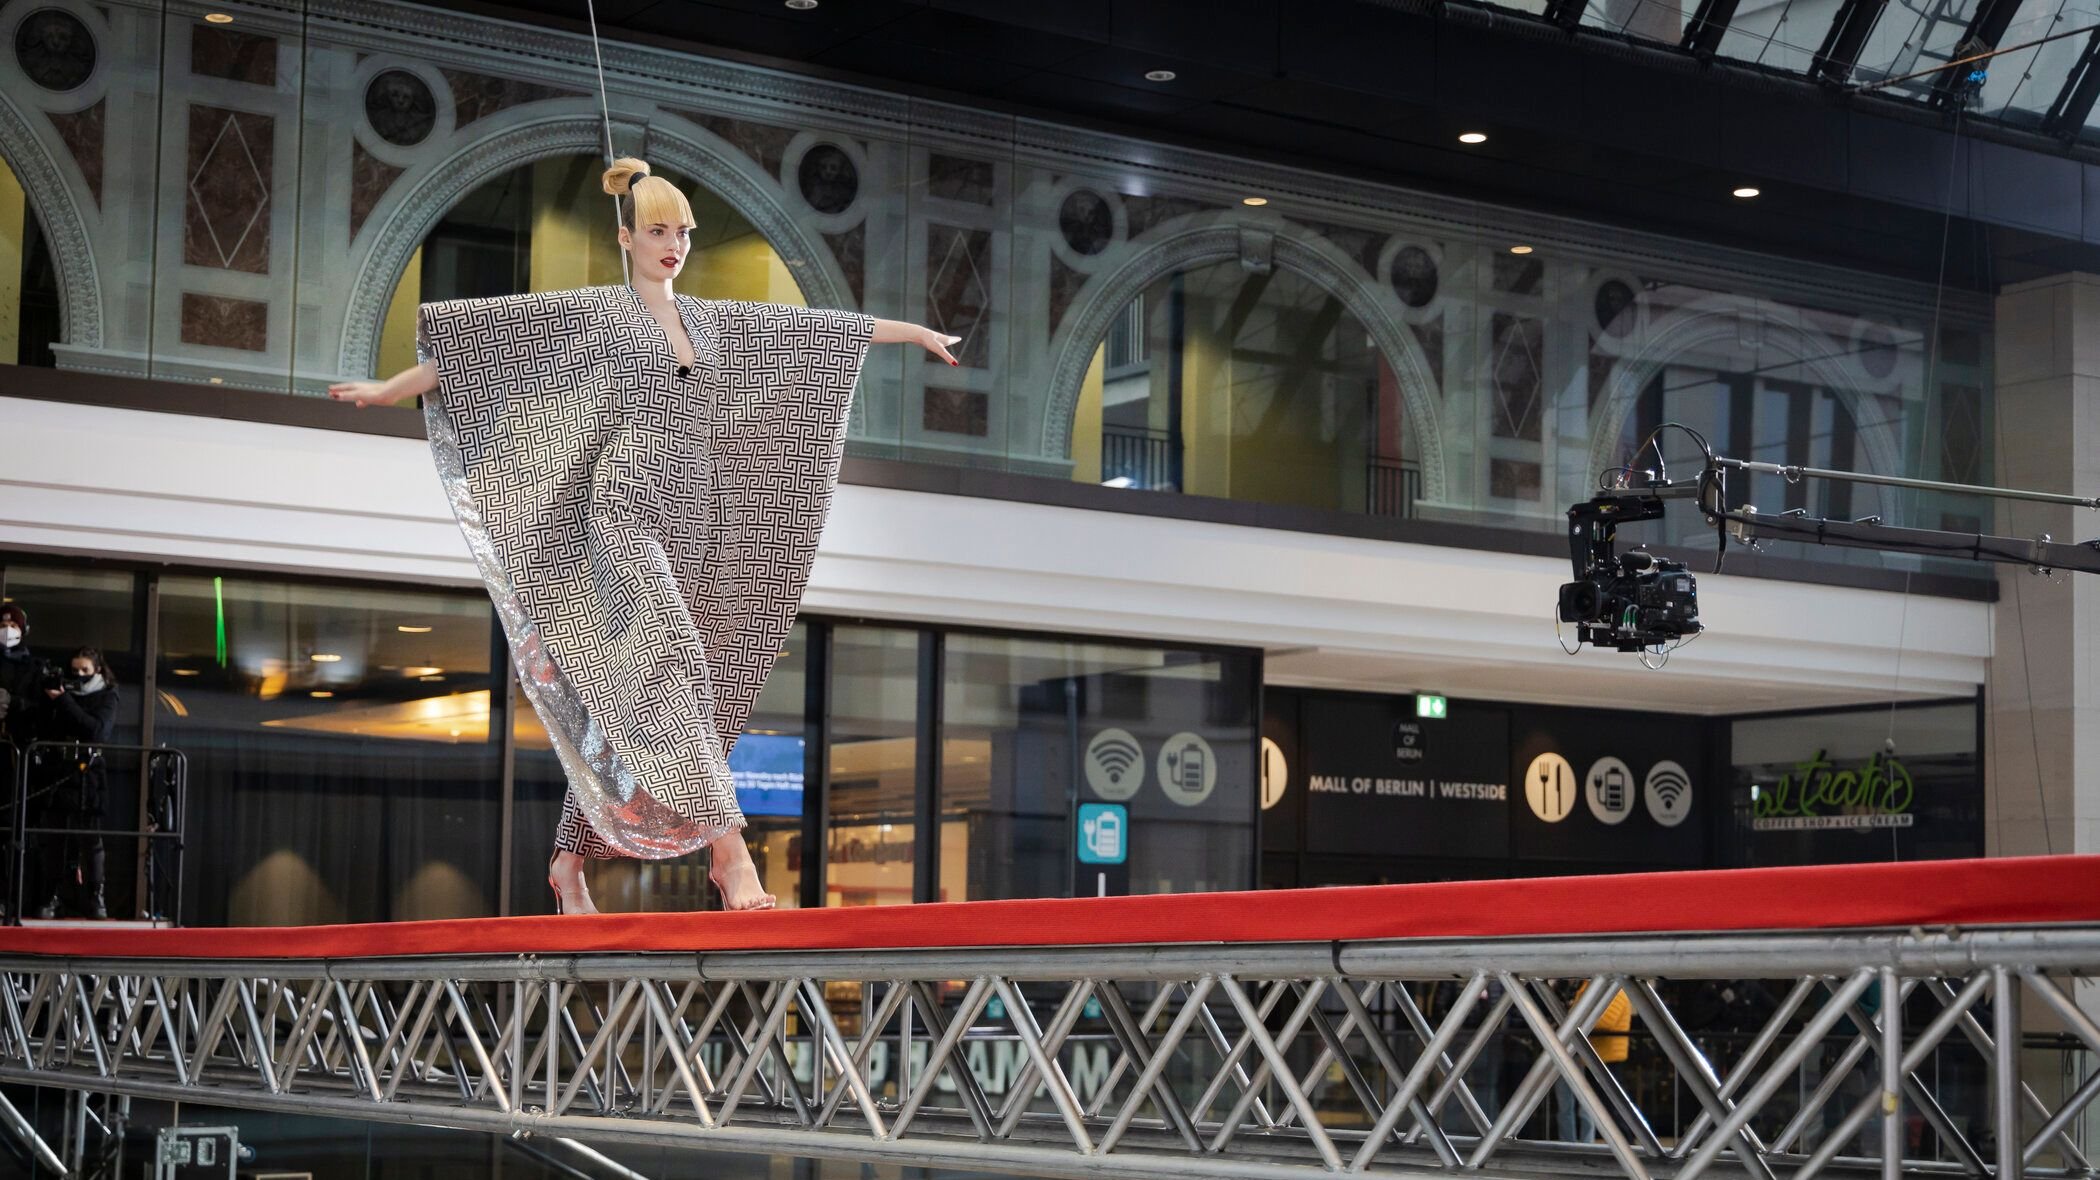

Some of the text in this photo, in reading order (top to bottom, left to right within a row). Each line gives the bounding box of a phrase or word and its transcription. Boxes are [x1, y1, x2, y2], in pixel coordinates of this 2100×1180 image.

[1403, 735, 1416, 746] OF
[1309, 775, 1348, 793] MALL
[1351, 777, 1372, 794] OF
[1375, 778, 1425, 797] BERLIN
[1440, 782, 1507, 800] WESTSIDE
[1755, 818, 1796, 829] COFFEE
[1802, 817, 1832, 828] SHOP
[1844, 816, 1862, 827] ICE
[1868, 814, 1910, 827] CREAM
